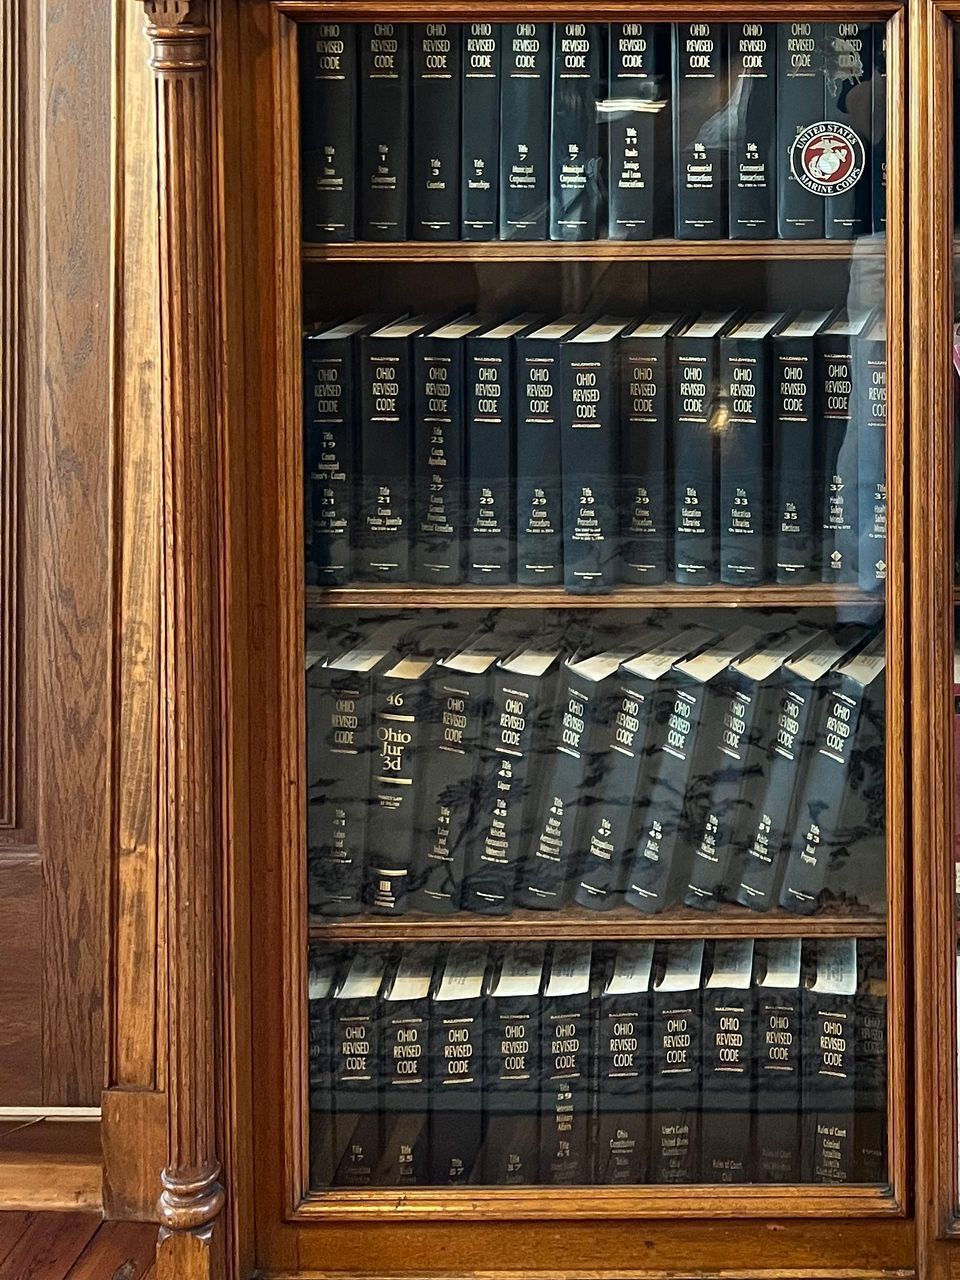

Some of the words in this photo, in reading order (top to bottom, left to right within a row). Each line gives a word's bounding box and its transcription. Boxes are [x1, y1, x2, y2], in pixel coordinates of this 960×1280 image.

[471, 24, 491, 36] OHIO
[468, 39, 496, 52] REVISED
[471, 55, 491, 68] CODE
[797, 124, 826, 149] UNITED
[827, 124, 857, 145] STATES
[800, 174, 834, 193] MARINE
[836, 167, 860, 191] CORPS
[479, 368, 497, 381] OHIO
[684, 367, 703, 381] OHIO
[475, 383, 501, 396] REVISED
[680, 383, 706, 397] REVISED
[478, 400, 498, 412] CODE
[683, 399, 703, 412] CODE
[480, 496, 494, 505] 29
[684, 497, 699, 505] 33
[386, 693, 404, 707] 46
[376, 726, 412, 744] Ohio
[380, 742, 404, 757] Jur
[383, 756, 402, 771] 3d
[397, 1029, 417, 1042] OHIO
[393, 1044, 421, 1058] REVISED
[397, 1060, 417, 1074] CODE
